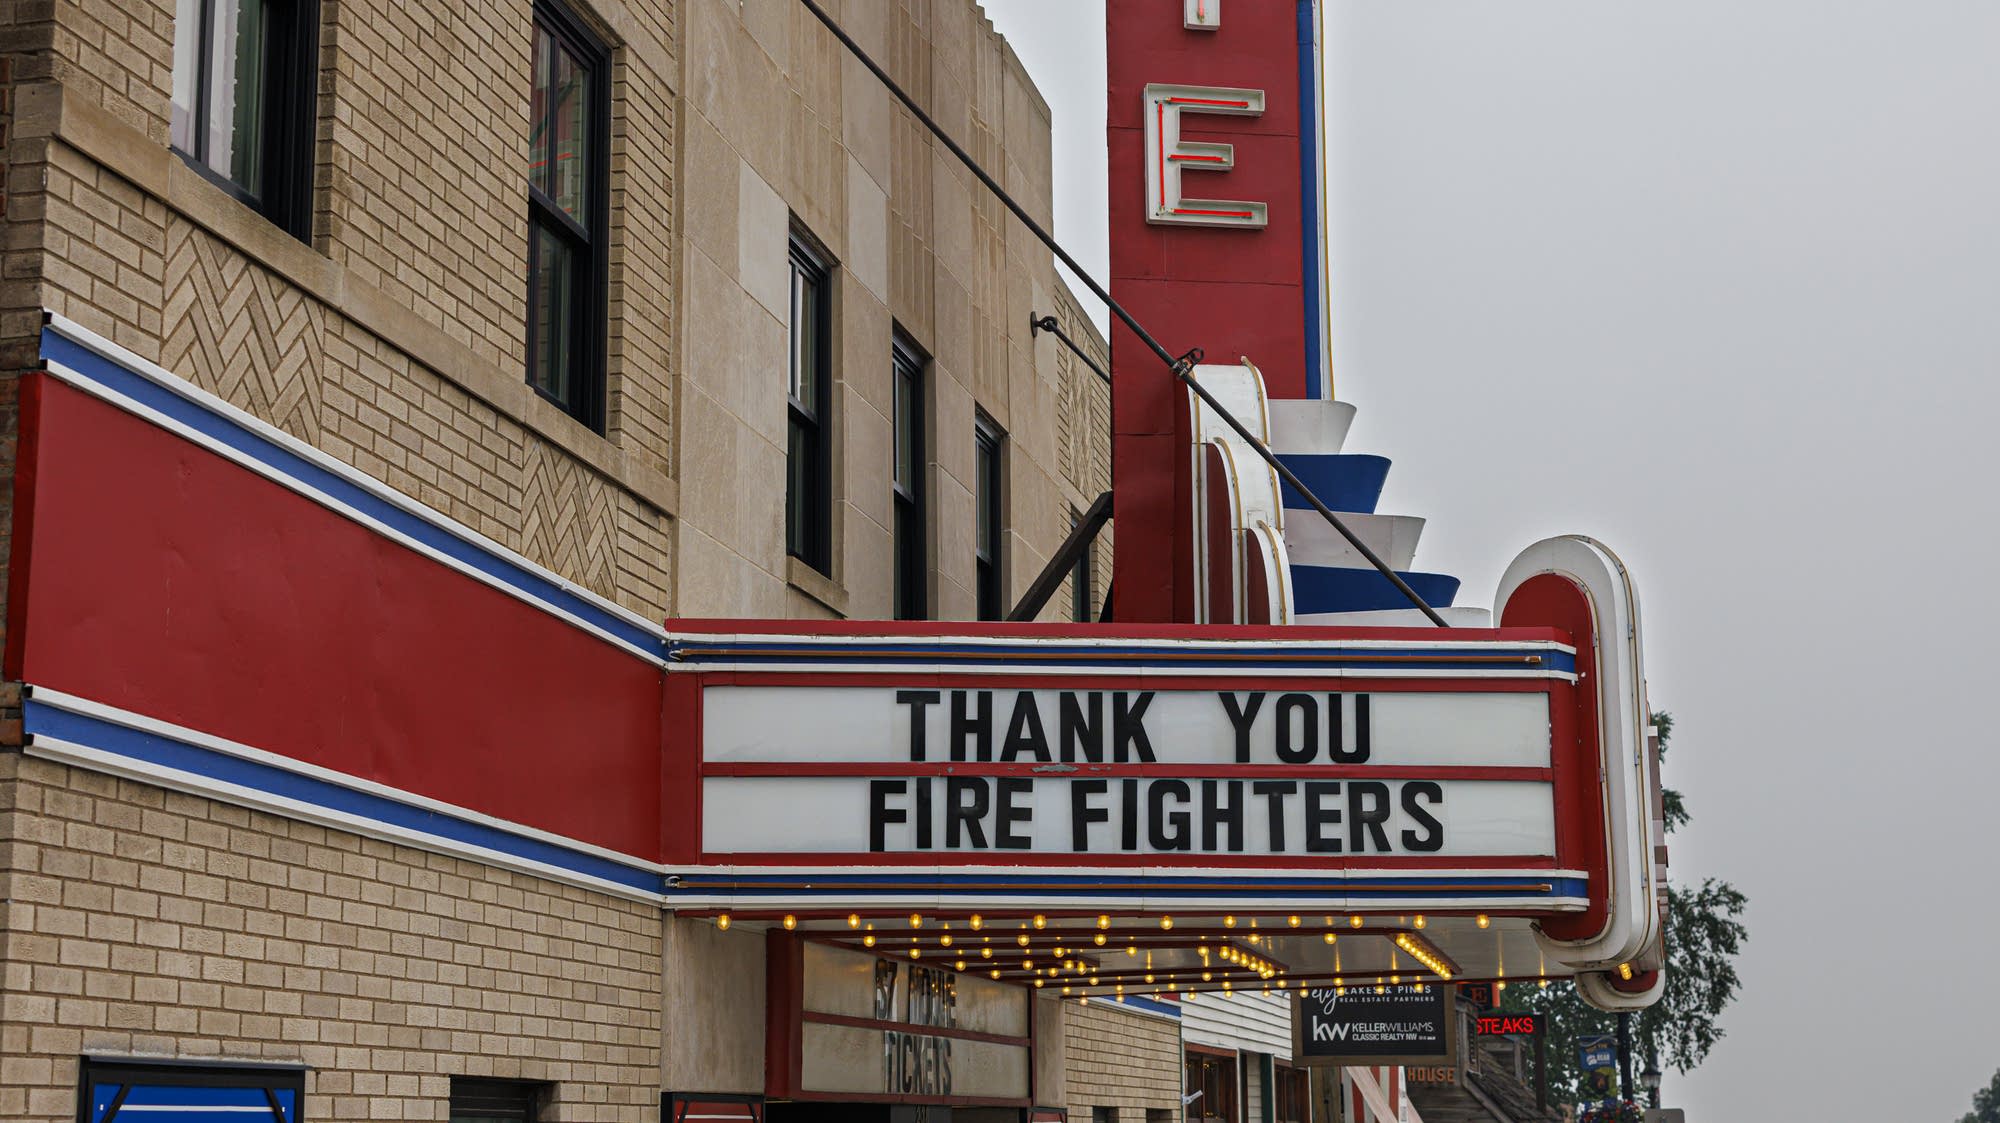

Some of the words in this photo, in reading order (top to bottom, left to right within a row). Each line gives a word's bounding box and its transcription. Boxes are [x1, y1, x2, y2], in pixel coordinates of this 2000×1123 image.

[896, 690, 1157, 763] THANK
[1217, 691, 1371, 764] YOU
[869, 776, 1034, 852] FIRE
[1070, 778, 1444, 853] FIGHTERS
[1397, 985, 1432, 994] PINS
[1312, 1015, 1350, 1041] kw
[1476, 1017, 1534, 1034] STEAKS
[1352, 1033, 1379, 1041] CLASSIC
[1380, 1033, 1405, 1041] REALTY
[1405, 1033, 1417, 1041] NW
[884, 1032, 952, 1094] TICKETS
[1407, 1066, 1456, 1085] HOUSE
